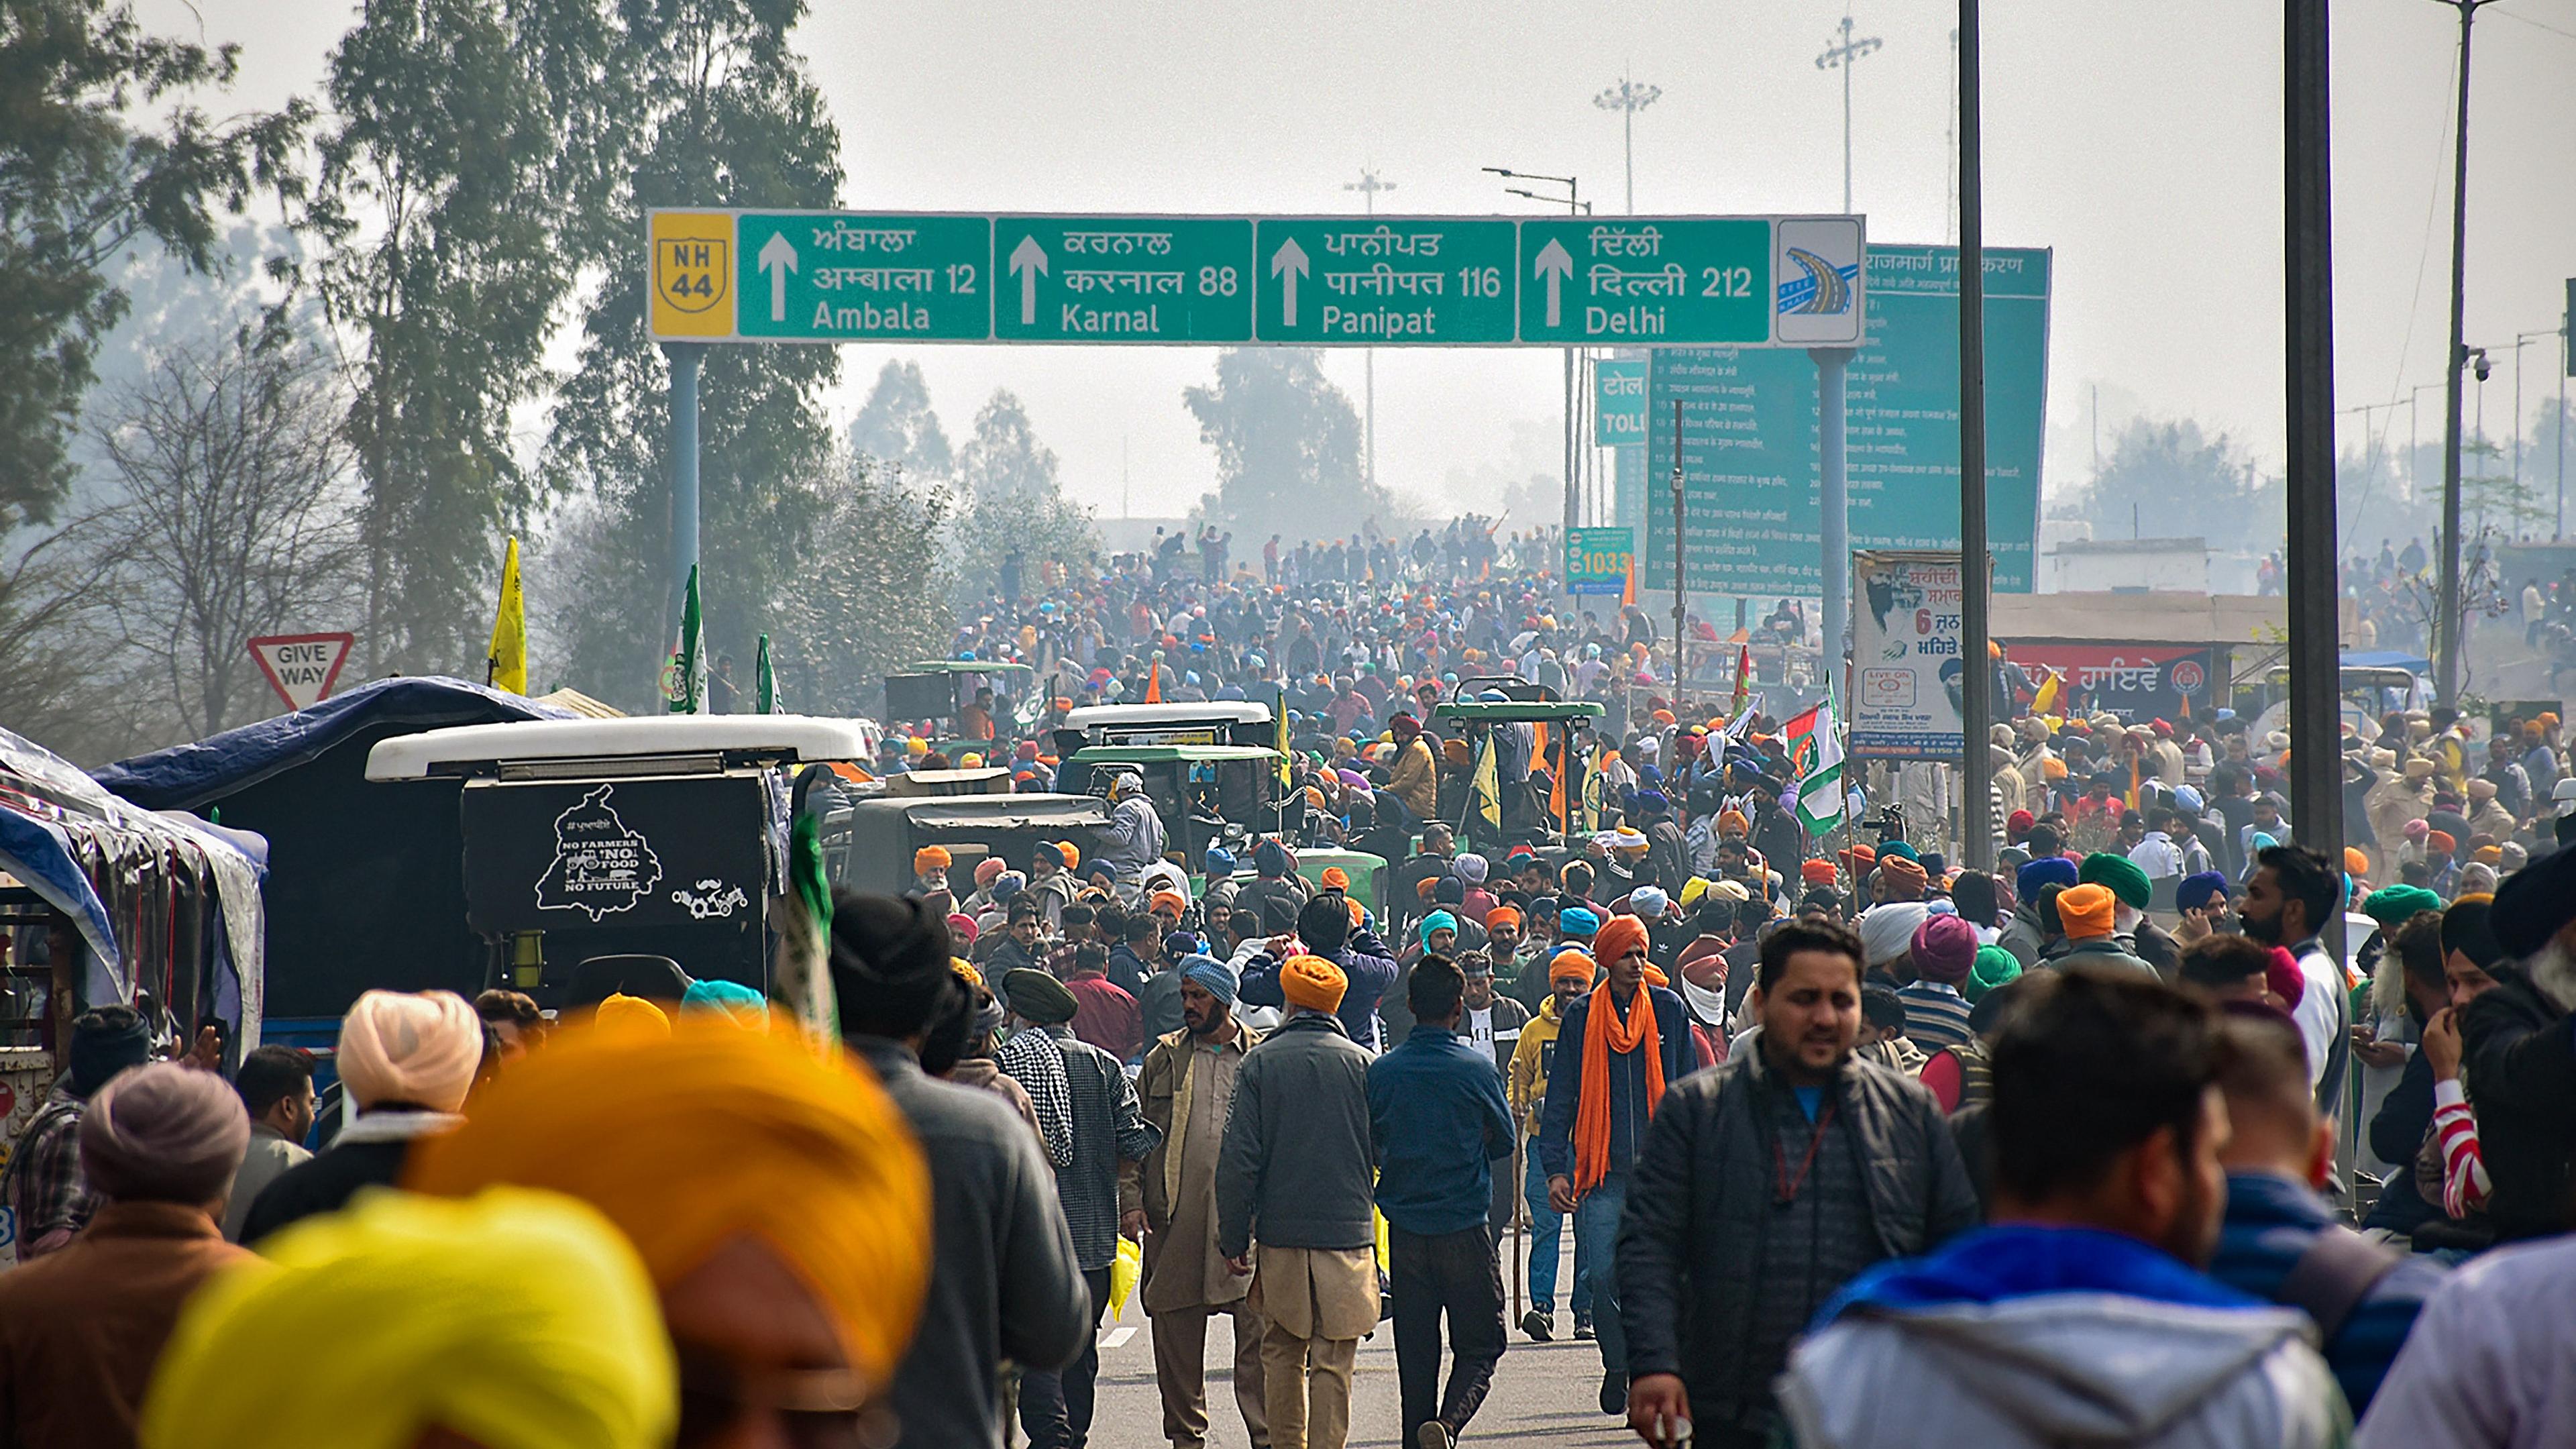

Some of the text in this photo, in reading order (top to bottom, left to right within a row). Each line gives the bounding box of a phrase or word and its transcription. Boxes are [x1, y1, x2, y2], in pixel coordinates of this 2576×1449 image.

[812, 223, 916, 252] ਅੰਬਾਲਾ
[1063, 232, 1173, 255] ਕਰਨਾਲ
[1325, 226, 1443, 256] ਪਾਨੀਪਤ
[1589, 226, 1663, 256] ਦਿੱਲੀ
[674, 245, 709, 267] NH
[672, 274, 713, 299] 44
[813, 264, 975, 294] अम्बाला 12
[1063, 266, 1237, 297] करनाल 88
[1326, 264, 1501, 297] पानीपत 116
[1589, 264, 1687, 297] दिल्ली
[1702, 267, 1752, 297] 212
[812, 301, 930, 330] Ambala
[1062, 303, 1160, 333] Karnal
[1323, 305, 1436, 339] Panipat
[1586, 306, 1665, 335] Delhi
[1603, 370, 1643, 396] टोल
[1603, 413, 1646, 433] TOLL
[1583, 552, 1630, 574] 1033
[1916, 608, 1932, 635] 6
[278, 645, 327, 663] GIVE
[279, 667, 327, 685] WAY
[562, 840, 639, 849] NO FARMERS
[604, 849, 633, 859] NO
[601, 859, 639, 869] FOOD
[565, 881, 640, 892] NO FUTURE
